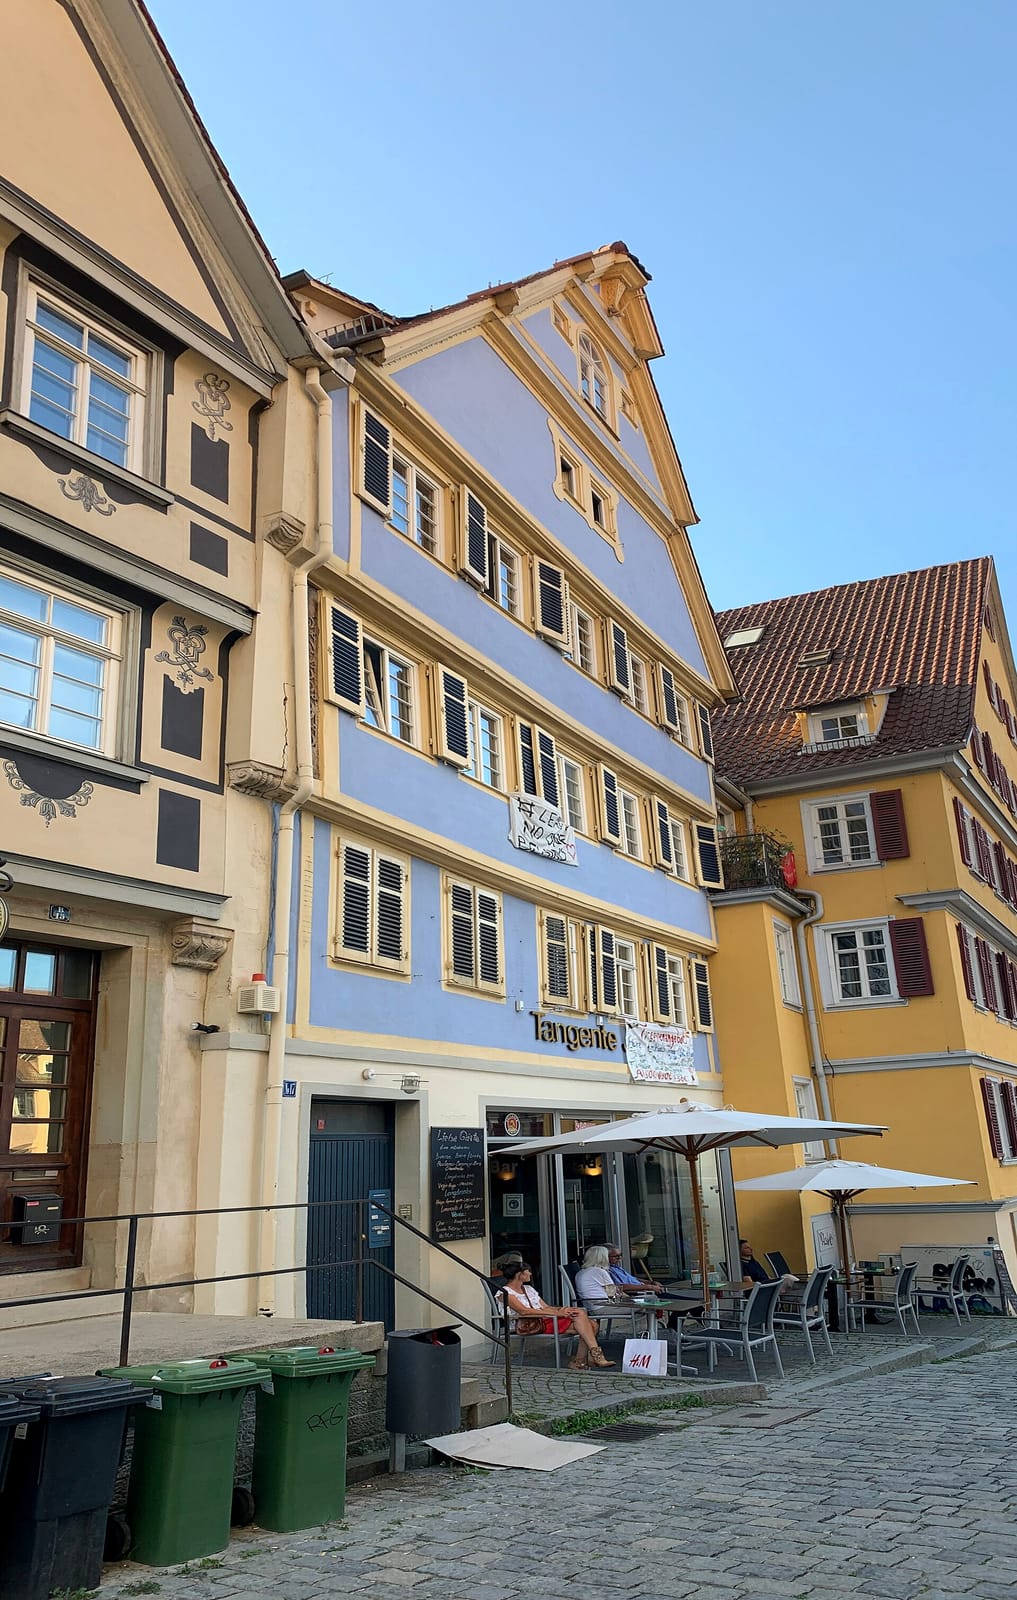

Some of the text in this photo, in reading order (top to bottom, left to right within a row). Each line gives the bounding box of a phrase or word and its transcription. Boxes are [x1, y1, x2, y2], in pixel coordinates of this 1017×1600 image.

[523, 820, 544, 840] NO
[529, 1011, 618, 1052] Tangente
[629, 1354, 652, 1369] H&M
